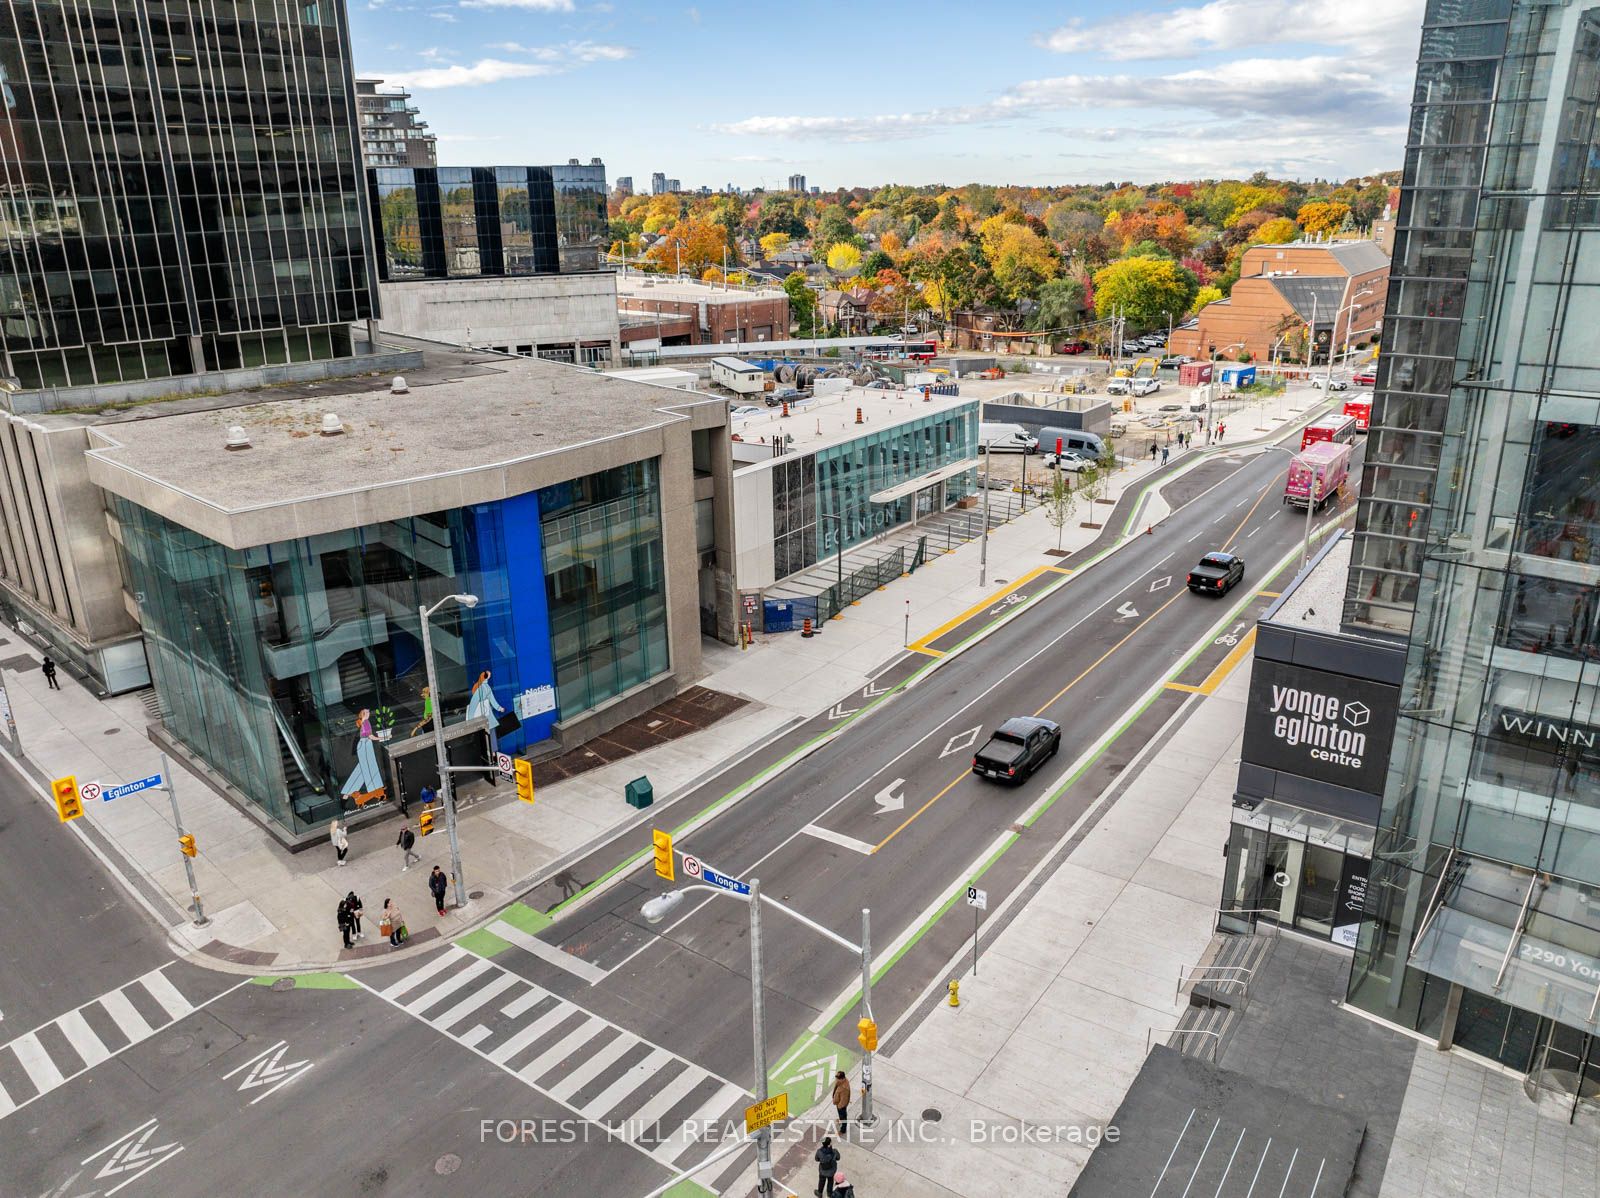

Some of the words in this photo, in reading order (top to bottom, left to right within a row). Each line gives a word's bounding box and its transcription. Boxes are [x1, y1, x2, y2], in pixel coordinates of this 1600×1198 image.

[525, 684, 551, 696] Notice
[1269, 684, 1340, 722] yonge
[1274, 715, 1366, 757] eglinton
[1501, 714, 1596, 748] WINN
[1310, 748, 1362, 768] centre
[108, 781, 145, 799] Eglinton
[713, 873, 739, 891] Yonge
[1349, 884, 1365, 892] FOOD
[1520, 943, 1566, 967] 2290
[754, 1104, 763, 1113] DO
[765, 1098, 778, 1107] NOT
[756, 1106, 777, 1120] BLOCK
[748, 1110, 786, 1132] INTERSECTION
